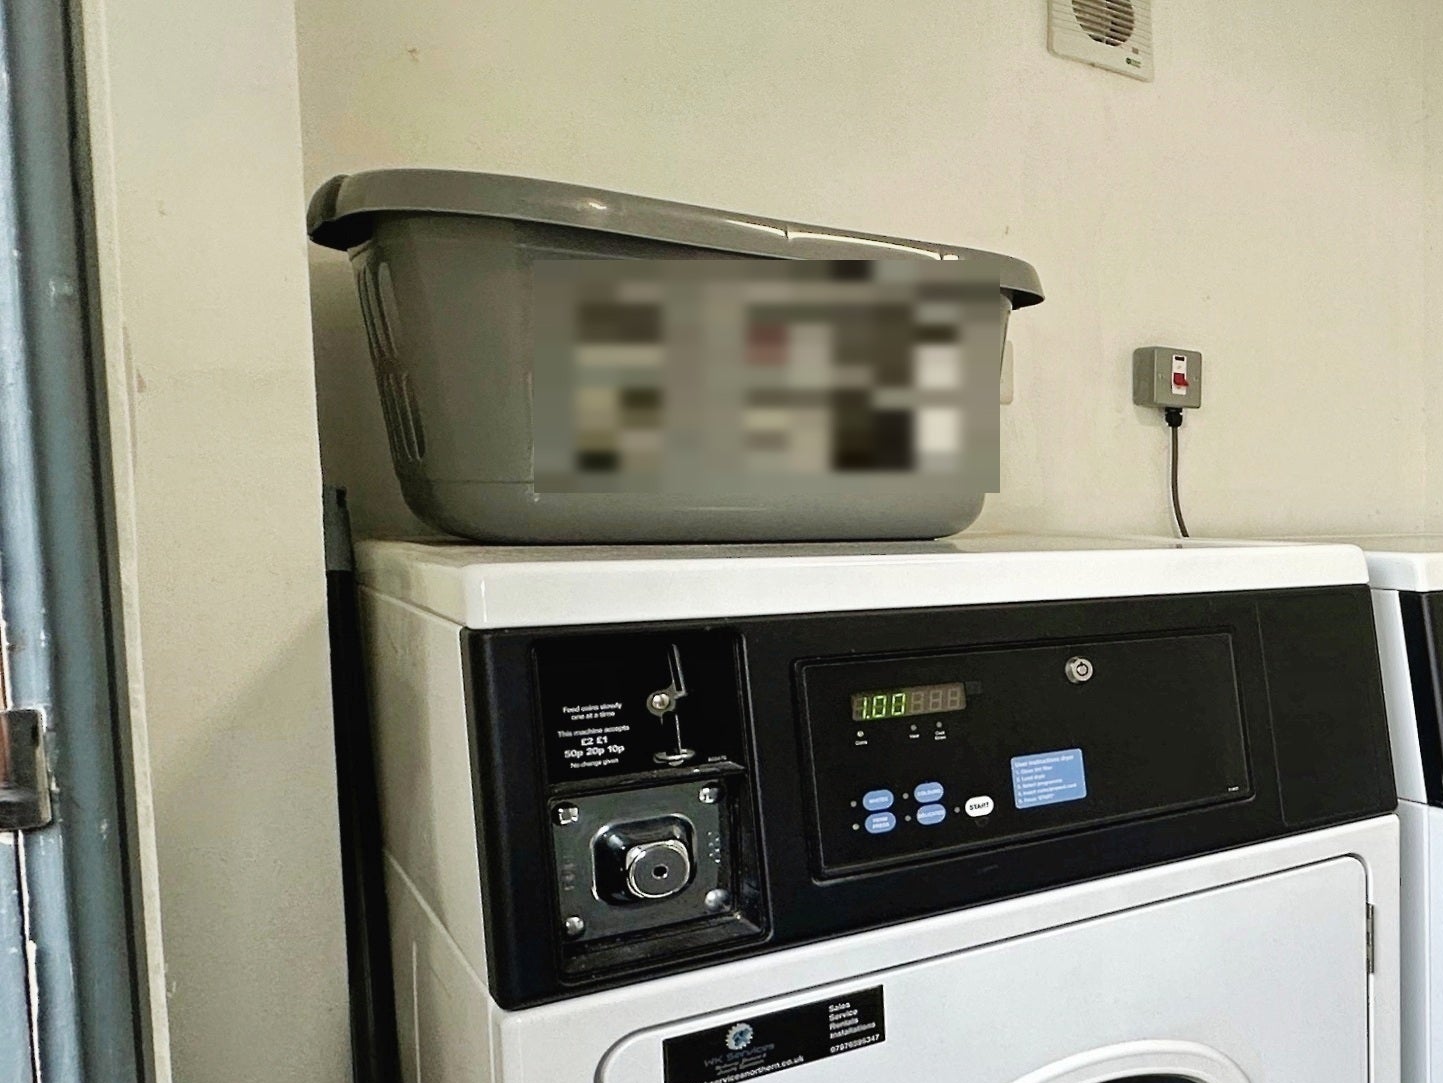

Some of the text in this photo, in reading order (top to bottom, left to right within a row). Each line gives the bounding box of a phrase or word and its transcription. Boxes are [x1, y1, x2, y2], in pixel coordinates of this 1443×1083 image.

[580, 735, 609, 746] £2 £1
[564, 744, 626, 758] 50p 20p 10p
[828, 1002, 851, 1012] Sales
[828, 1008, 858, 1021] Service
